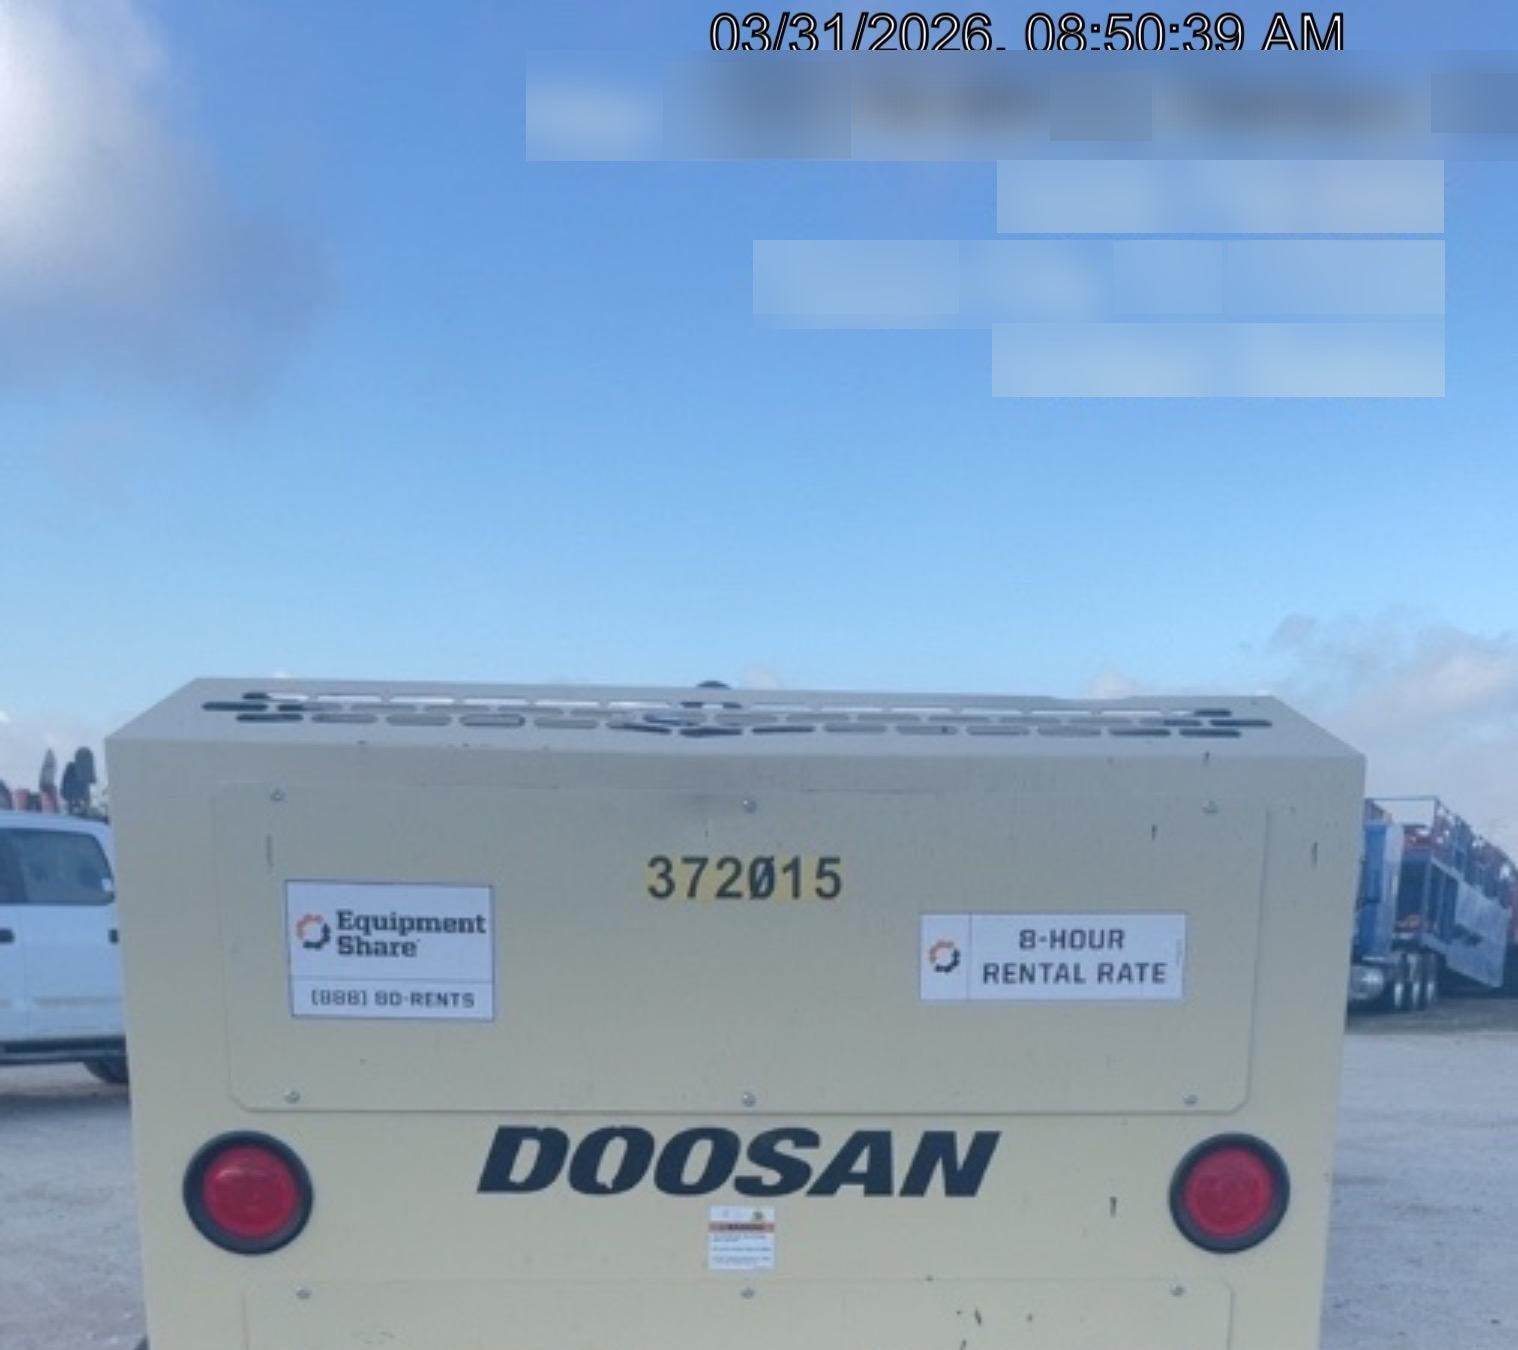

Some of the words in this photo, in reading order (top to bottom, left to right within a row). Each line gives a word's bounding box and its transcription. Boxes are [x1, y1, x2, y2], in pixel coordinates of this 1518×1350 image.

[647, 856, 842, 899] 372015
[336, 910, 487, 936] Equipment
[337, 935, 418, 957] Share
[1018, 929, 1126, 950] 8-HOUR
[982, 962, 1087, 985] RENTAL
[1097, 962, 1168, 984] RATE
[311, 989, 367, 1007] (888)
[477, 1126, 1002, 1198] DOOSAN
